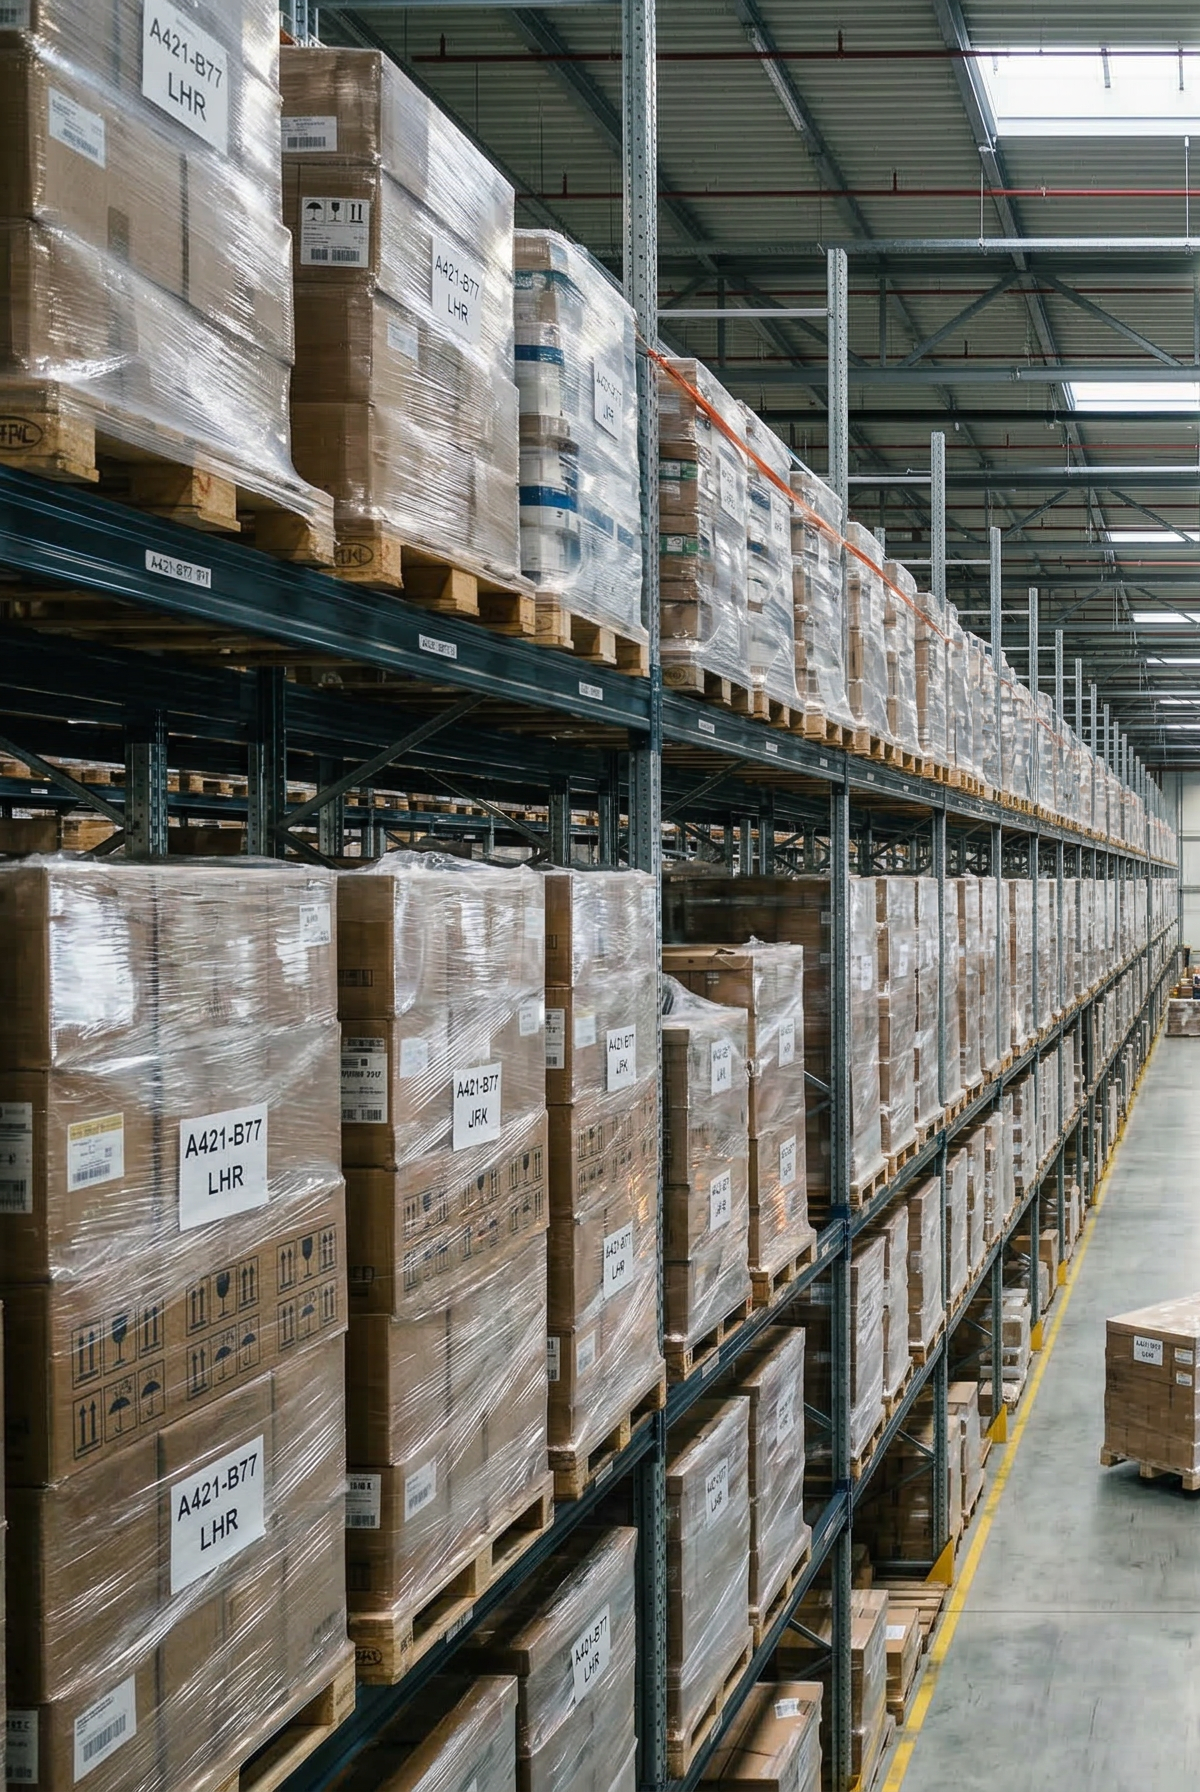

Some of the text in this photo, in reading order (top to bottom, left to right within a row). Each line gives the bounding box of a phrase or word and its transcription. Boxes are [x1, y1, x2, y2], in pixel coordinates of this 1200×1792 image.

[149, 18, 223, 88] A421-B77
[168, 72, 207, 121] LHR
[435, 255, 480, 301] A421-B77
[448, 294, 469, 326] LHR
[456, 1074, 499, 1099] A421-B77
[184, 1118, 262, 1160] A421-B77
[208, 1164, 244, 1196] LHR
[177, 1453, 258, 1522] A421-B77
[200, 1507, 239, 1552] LHR
[583, 1651, 600, 1683] LHR
